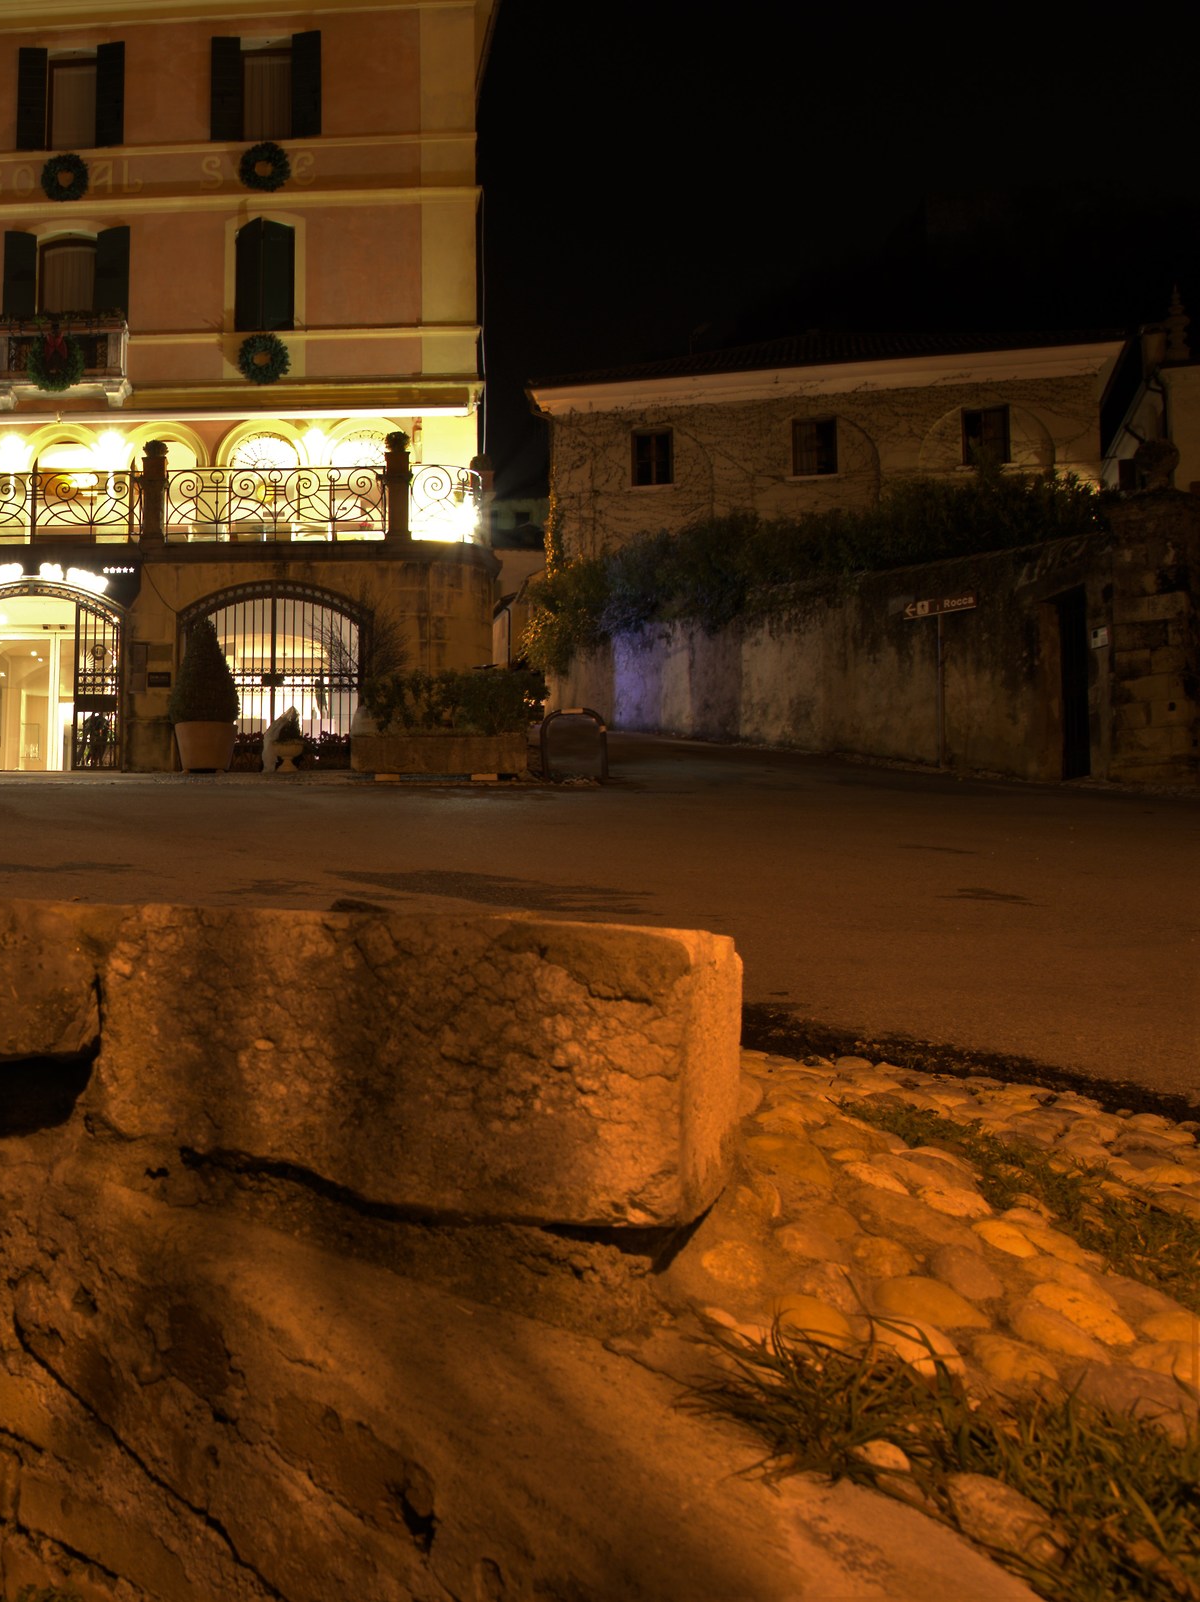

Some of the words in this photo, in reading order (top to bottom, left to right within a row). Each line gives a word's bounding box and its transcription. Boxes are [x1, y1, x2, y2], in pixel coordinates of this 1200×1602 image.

[88, 159, 144, 194] AL
[200, 151, 317, 190] SE
[943, 596, 974, 608] Rocca
